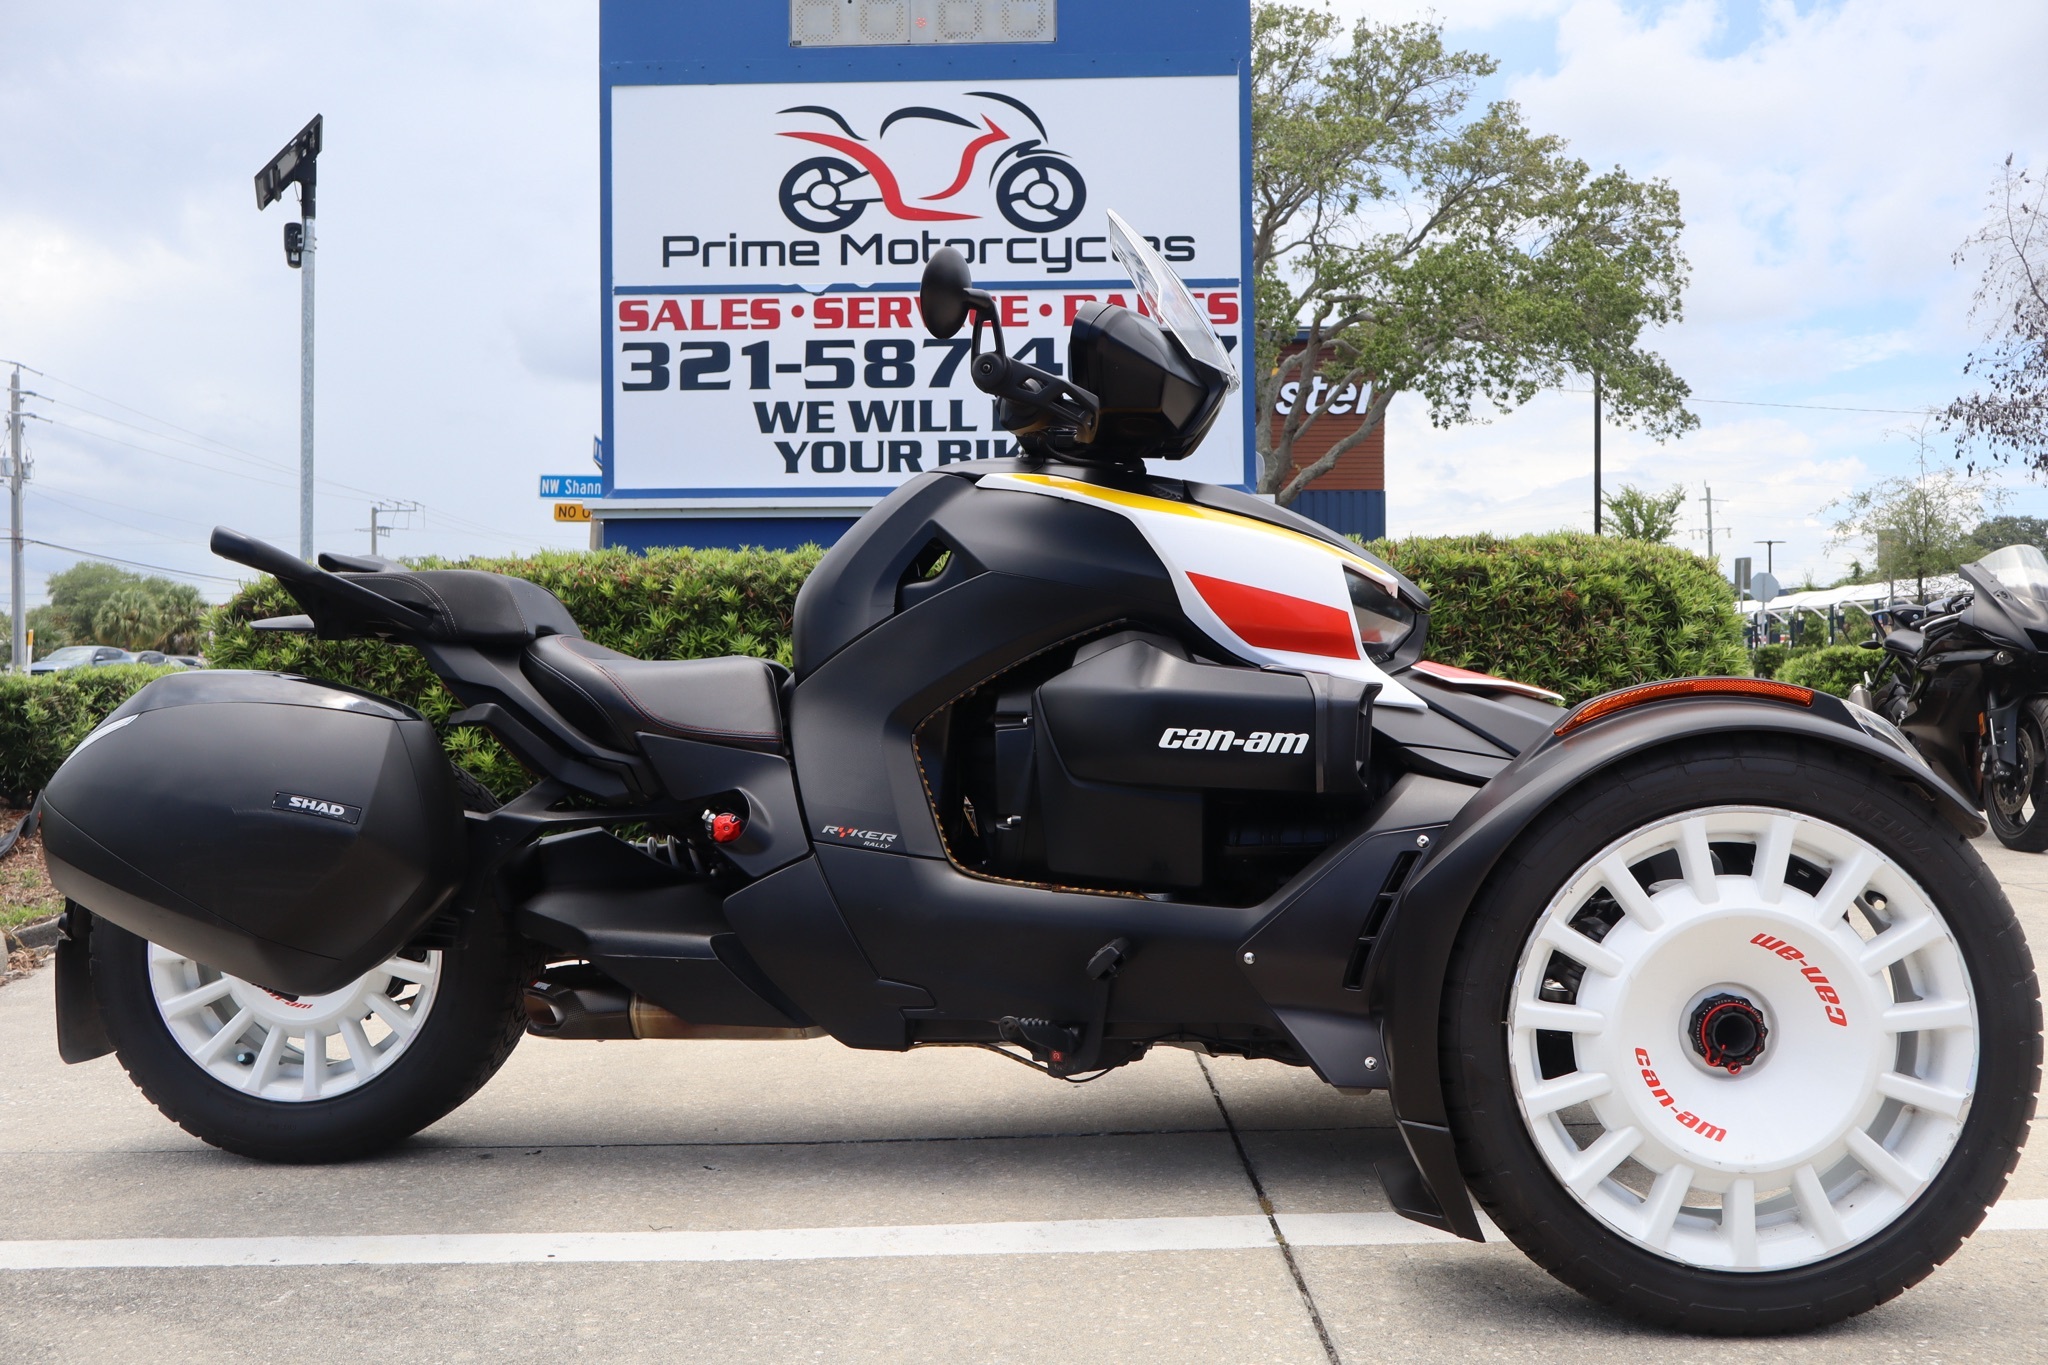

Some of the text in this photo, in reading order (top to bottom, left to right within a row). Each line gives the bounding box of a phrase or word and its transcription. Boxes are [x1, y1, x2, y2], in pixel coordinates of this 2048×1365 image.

[663, 233, 820, 268] Prime
[618, 297, 782, 332] SALES
[813, 295, 1030, 329] SERE
[752, 399, 836, 434] WE
[847, 399, 978, 433] WILL
[774, 440, 924, 473] YOUR
[541, 479, 560, 494] NW
[558, 505, 577, 518] NO
[1158, 727, 1310, 754] can-am
[288, 796, 345, 816] SHAD
[821, 825, 898, 842] RYKER
[863, 840, 891, 849] RALLY
[1750, 933, 1848, 1027] can-am
[1635, 1047, 1727, 1142] can-am
